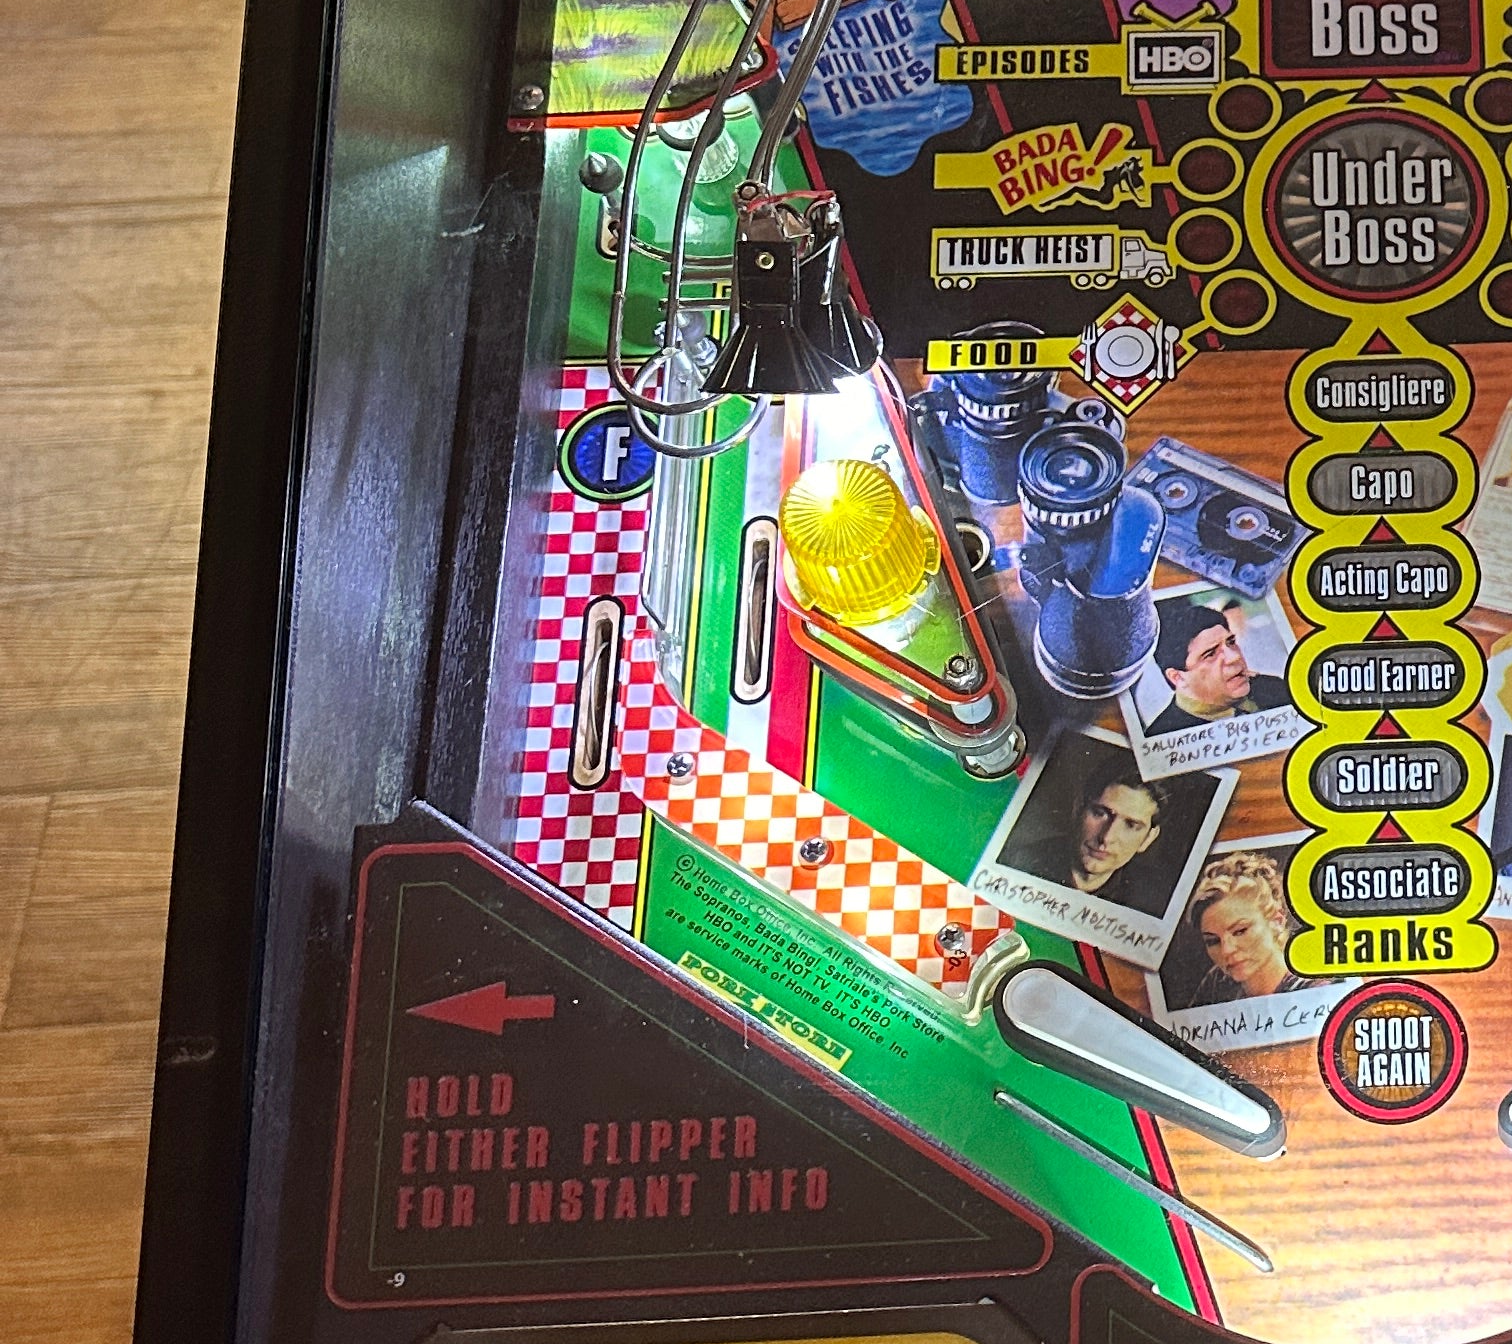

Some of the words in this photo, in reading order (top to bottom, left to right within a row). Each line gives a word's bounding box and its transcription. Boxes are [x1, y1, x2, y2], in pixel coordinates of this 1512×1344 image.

[816, 50, 868, 78] WITH
[874, 42, 915, 72] THE
[956, 48, 1091, 75] EPISODES
[1138, 45, 1212, 73] HBO
[823, 58, 932, 117] FISHES
[994, 128, 1080, 175] BADA
[998, 129, 1123, 208] BING!
[1312, 151, 1453, 207] Under
[946, 238, 1026, 267] TRUCK
[1032, 236, 1105, 266] HEIST
[1323, 209, 1437, 266] Boss
[950, 343, 1039, 367] FOOD
[1316, 375, 1446, 412] Consigliere
[602, 426, 631, 481] F
[1351, 465, 1414, 505] Capo
[1320, 563, 1389, 600] Acting
[1396, 562, 1448, 598] Capo
[1321, 660, 1376, 694] Good
[1381, 660, 1456, 693] Earner
[1141, 727, 1216, 756] SALVATORE
[1337, 755, 1440, 796] Soldier
[972, 867, 1069, 920] CHRISTOPHER
[1323, 859, 1461, 902] Associate
[670, 871, 692, 891] The
[694, 885, 751, 930] Sopranos,
[754, 922, 786, 947] Bada
[824, 964, 880, 1004] Satriale's
[881, 997, 910, 1023] Pork
[911, 1017, 946, 1043] Store
[1323, 922, 1454, 965] Ranks
[1254, 1015, 1274, 1032] LA
[1354, 1015, 1433, 1052] SHOOT
[1357, 1049, 1432, 1087] AGAIN
[406, 1072, 514, 1119] HOLD
[401, 1125, 549, 1174] EITHER
[583, 1114, 757, 1166] FLIPPER
[398, 1184, 475, 1230] FOR
[507, 1173, 698, 1226] INSTANT
[729, 1167, 829, 1216] INFO
